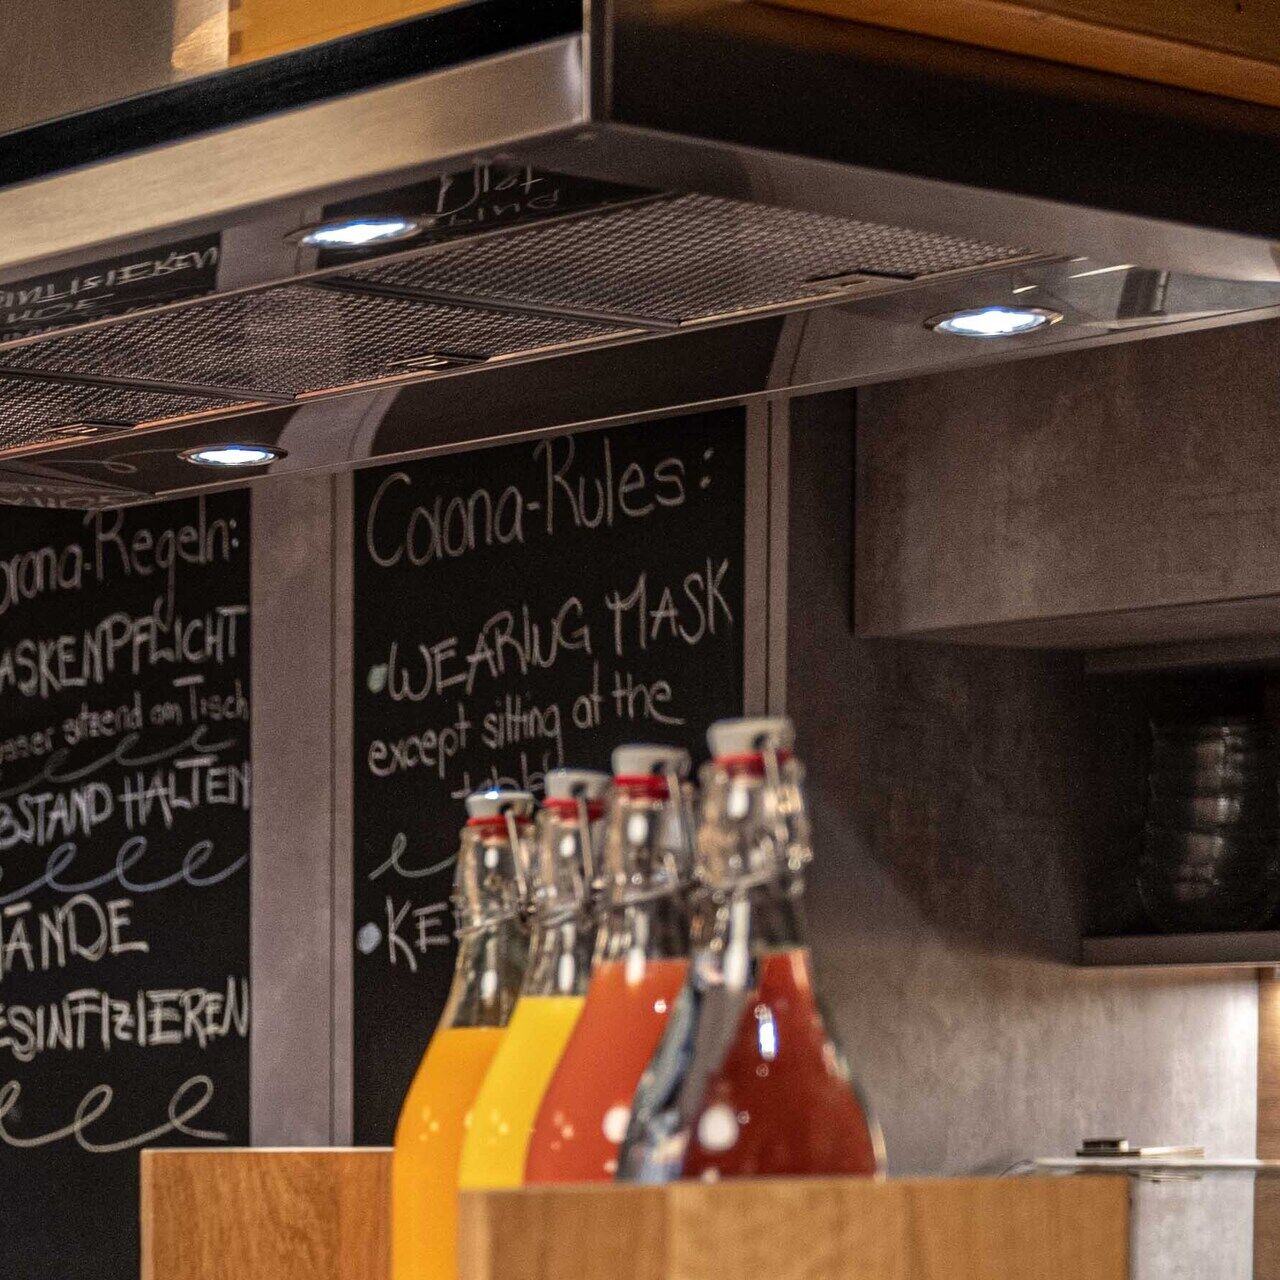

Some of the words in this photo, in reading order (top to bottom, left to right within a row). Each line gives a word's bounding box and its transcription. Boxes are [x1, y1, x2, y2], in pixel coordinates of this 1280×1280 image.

[387, 596, 592, 702] WEARING
[605, 556, 733, 657] MASK
[367, 703, 472, 779] except
[482, 690, 565, 766] sitting
[572, 661, 604, 729] at
[612, 671, 687, 726] the
[120, 755, 250, 829] HALTEN
